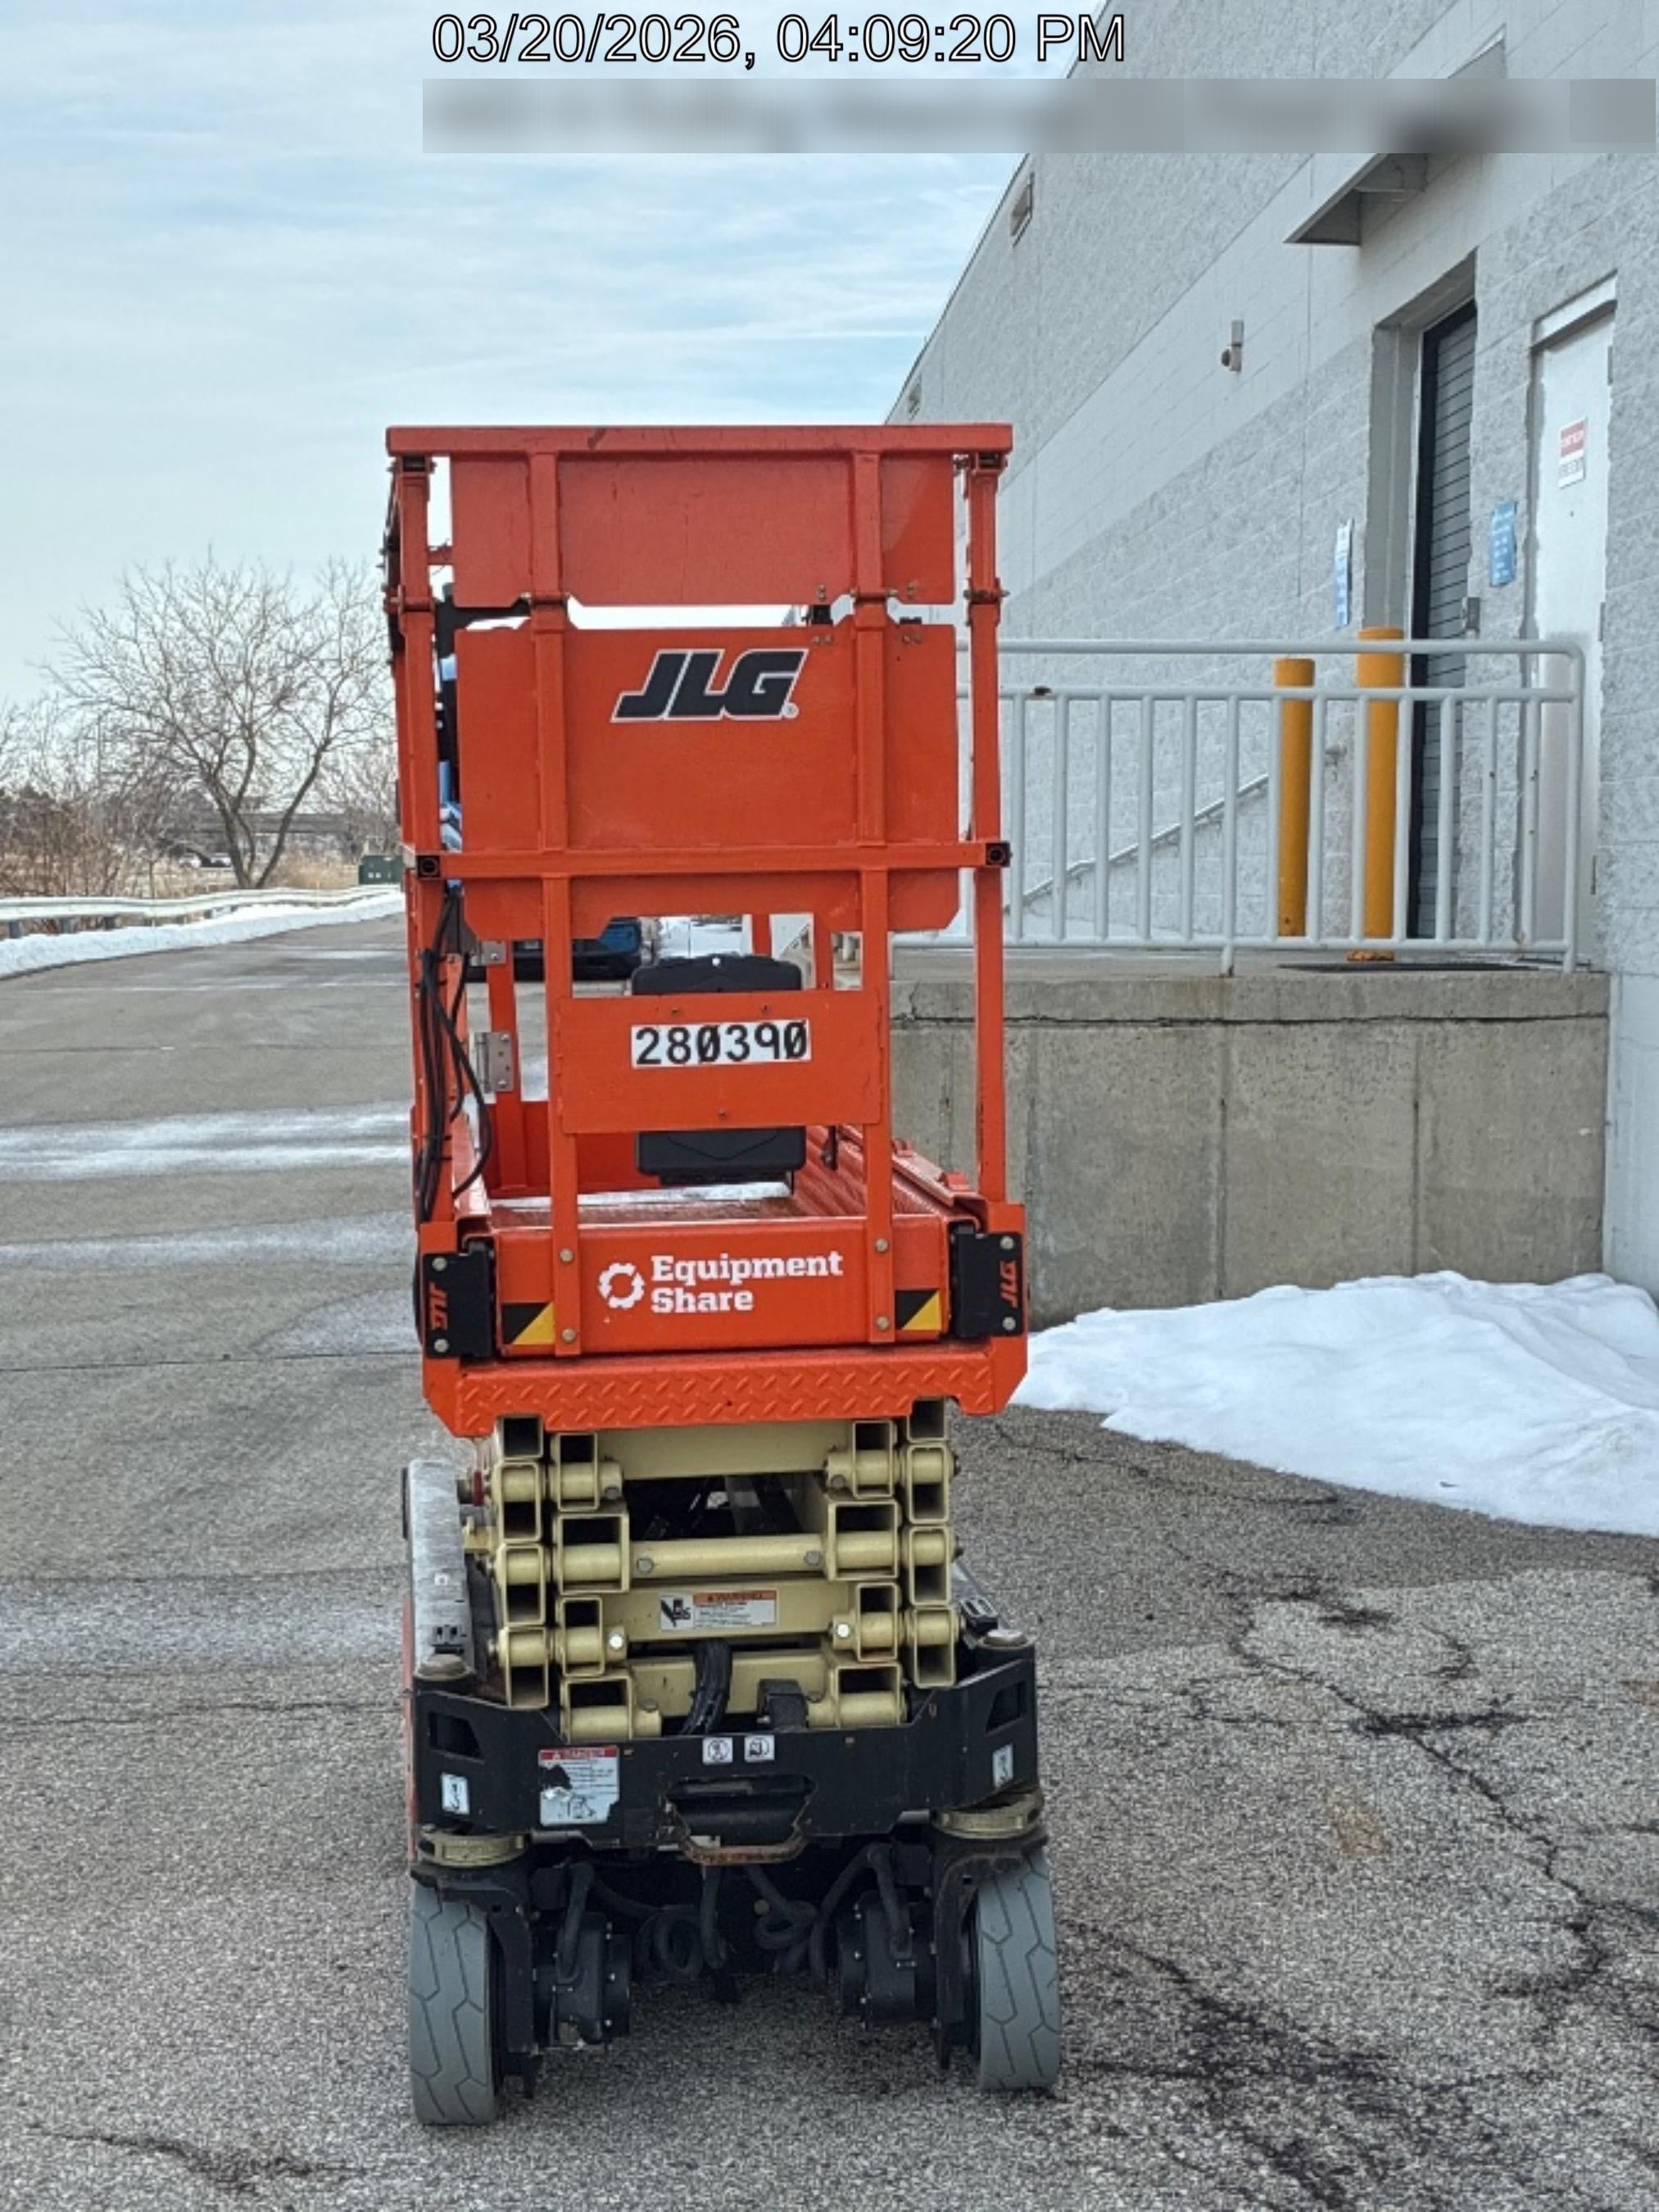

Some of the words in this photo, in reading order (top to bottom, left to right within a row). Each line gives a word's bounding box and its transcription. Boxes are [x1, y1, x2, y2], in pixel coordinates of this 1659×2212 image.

[610, 648, 809, 723] JLG
[636, 1022, 808, 1064] 280390
[650, 1251, 844, 1285] Equipment
[999, 1260, 1018, 1308] JLG
[429, 1282, 448, 1330] JLG
[650, 1287, 754, 1313] Share
